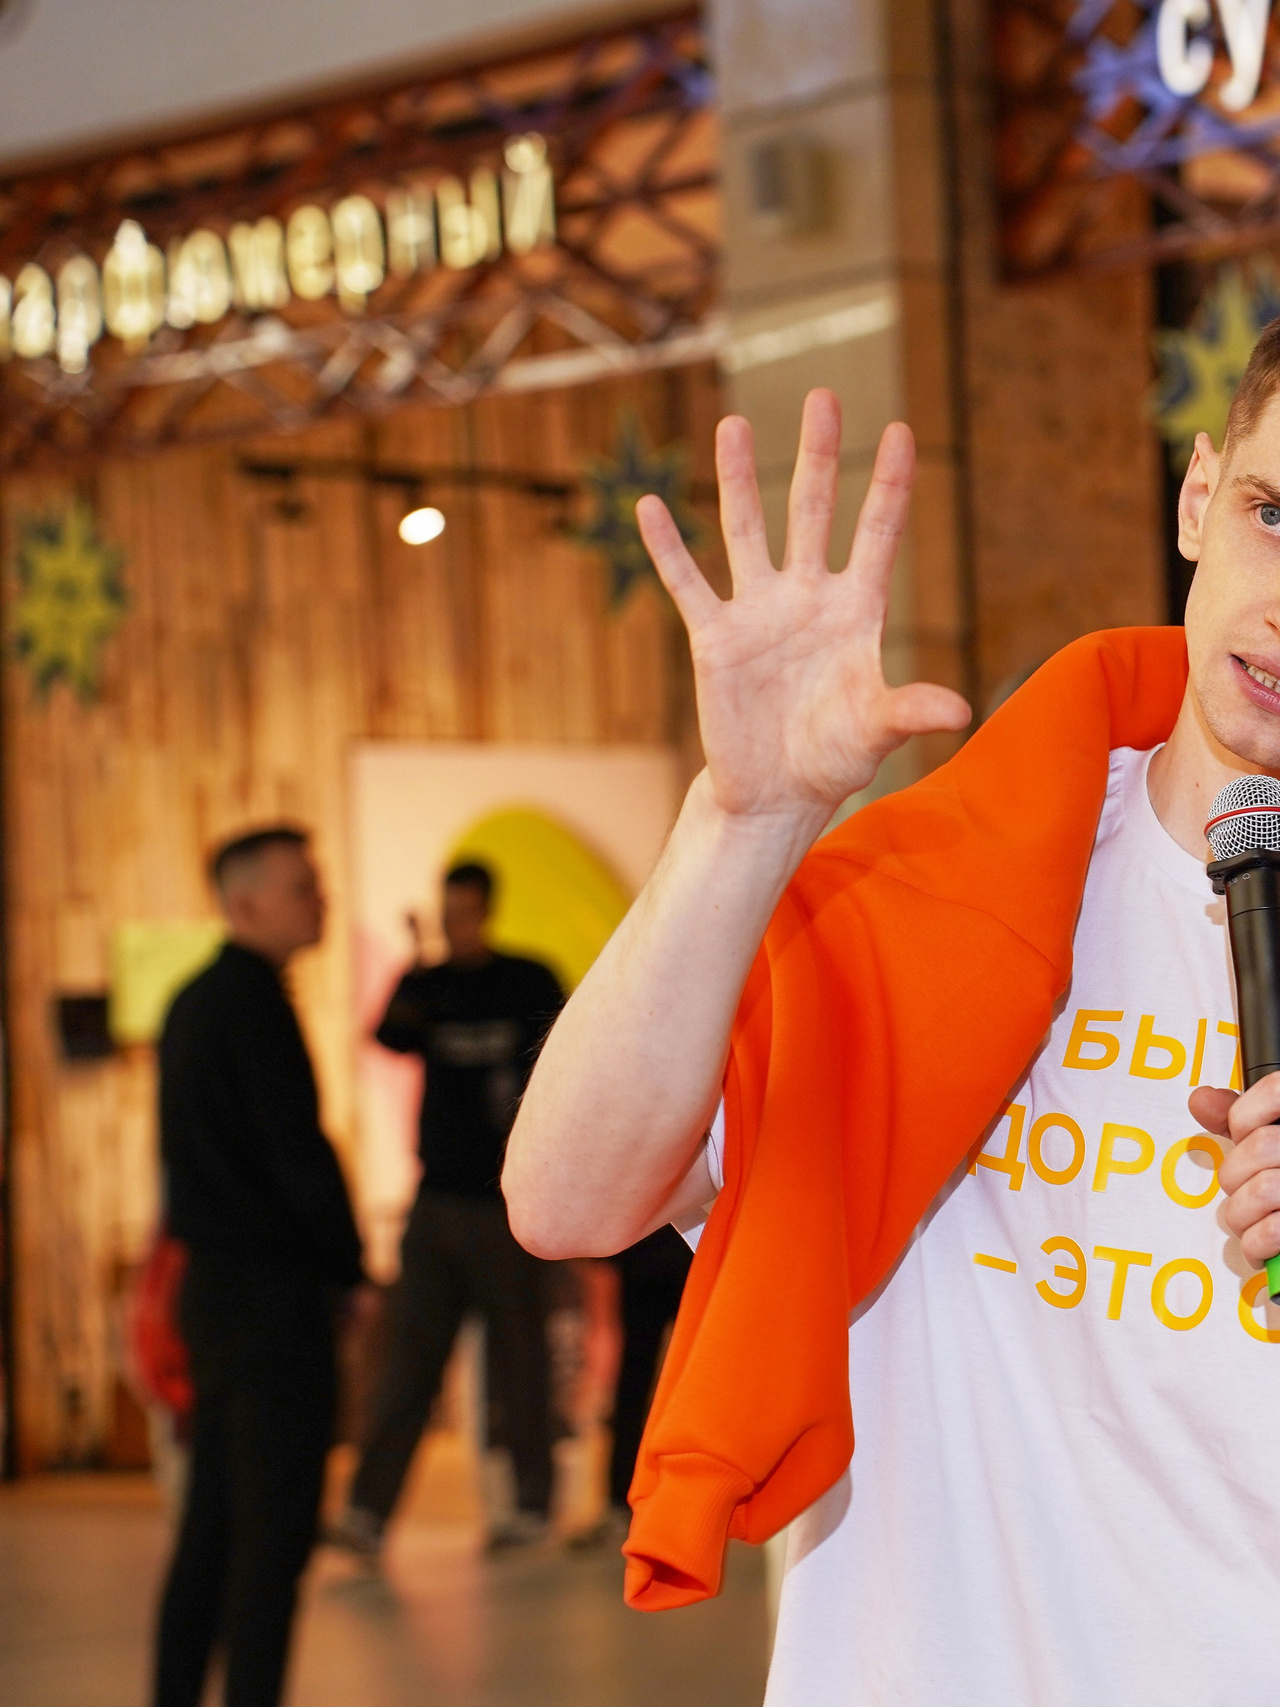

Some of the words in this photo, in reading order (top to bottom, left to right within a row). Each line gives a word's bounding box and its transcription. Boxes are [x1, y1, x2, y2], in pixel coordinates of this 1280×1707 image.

[0, 131, 558, 374] арфюмерный
[966, 1103, 1225, 1209] ДОРО
[1035, 1235, 1214, 1331] ЭТО
